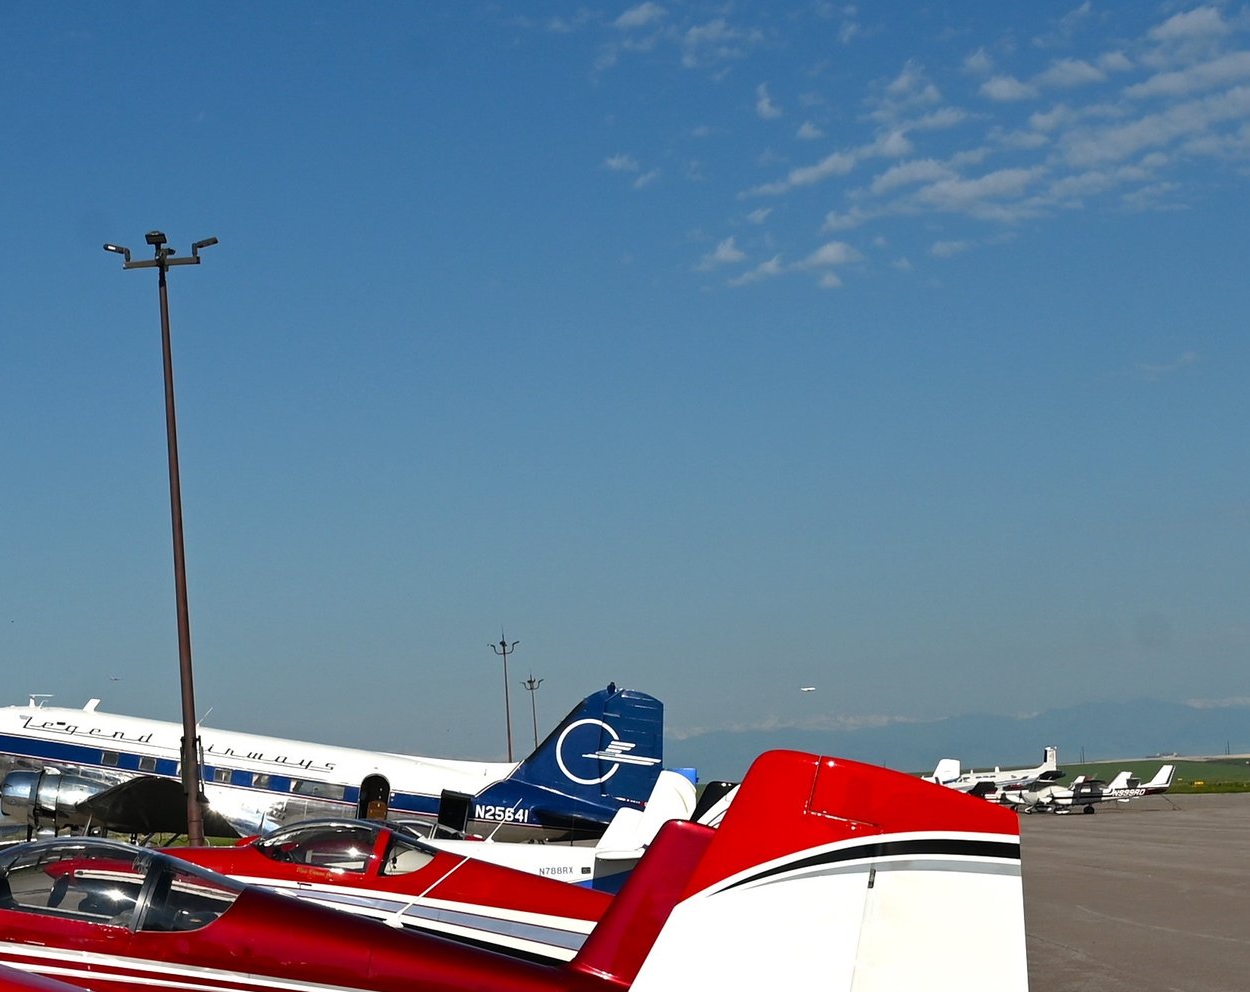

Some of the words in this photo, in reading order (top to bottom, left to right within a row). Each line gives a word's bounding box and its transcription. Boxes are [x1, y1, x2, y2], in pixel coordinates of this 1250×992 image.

[23, 715, 154, 744] Legend
[205, 743, 337, 771] irways
[474, 804, 529, 823] N25641
[539, 866, 574, 876] N788RX
